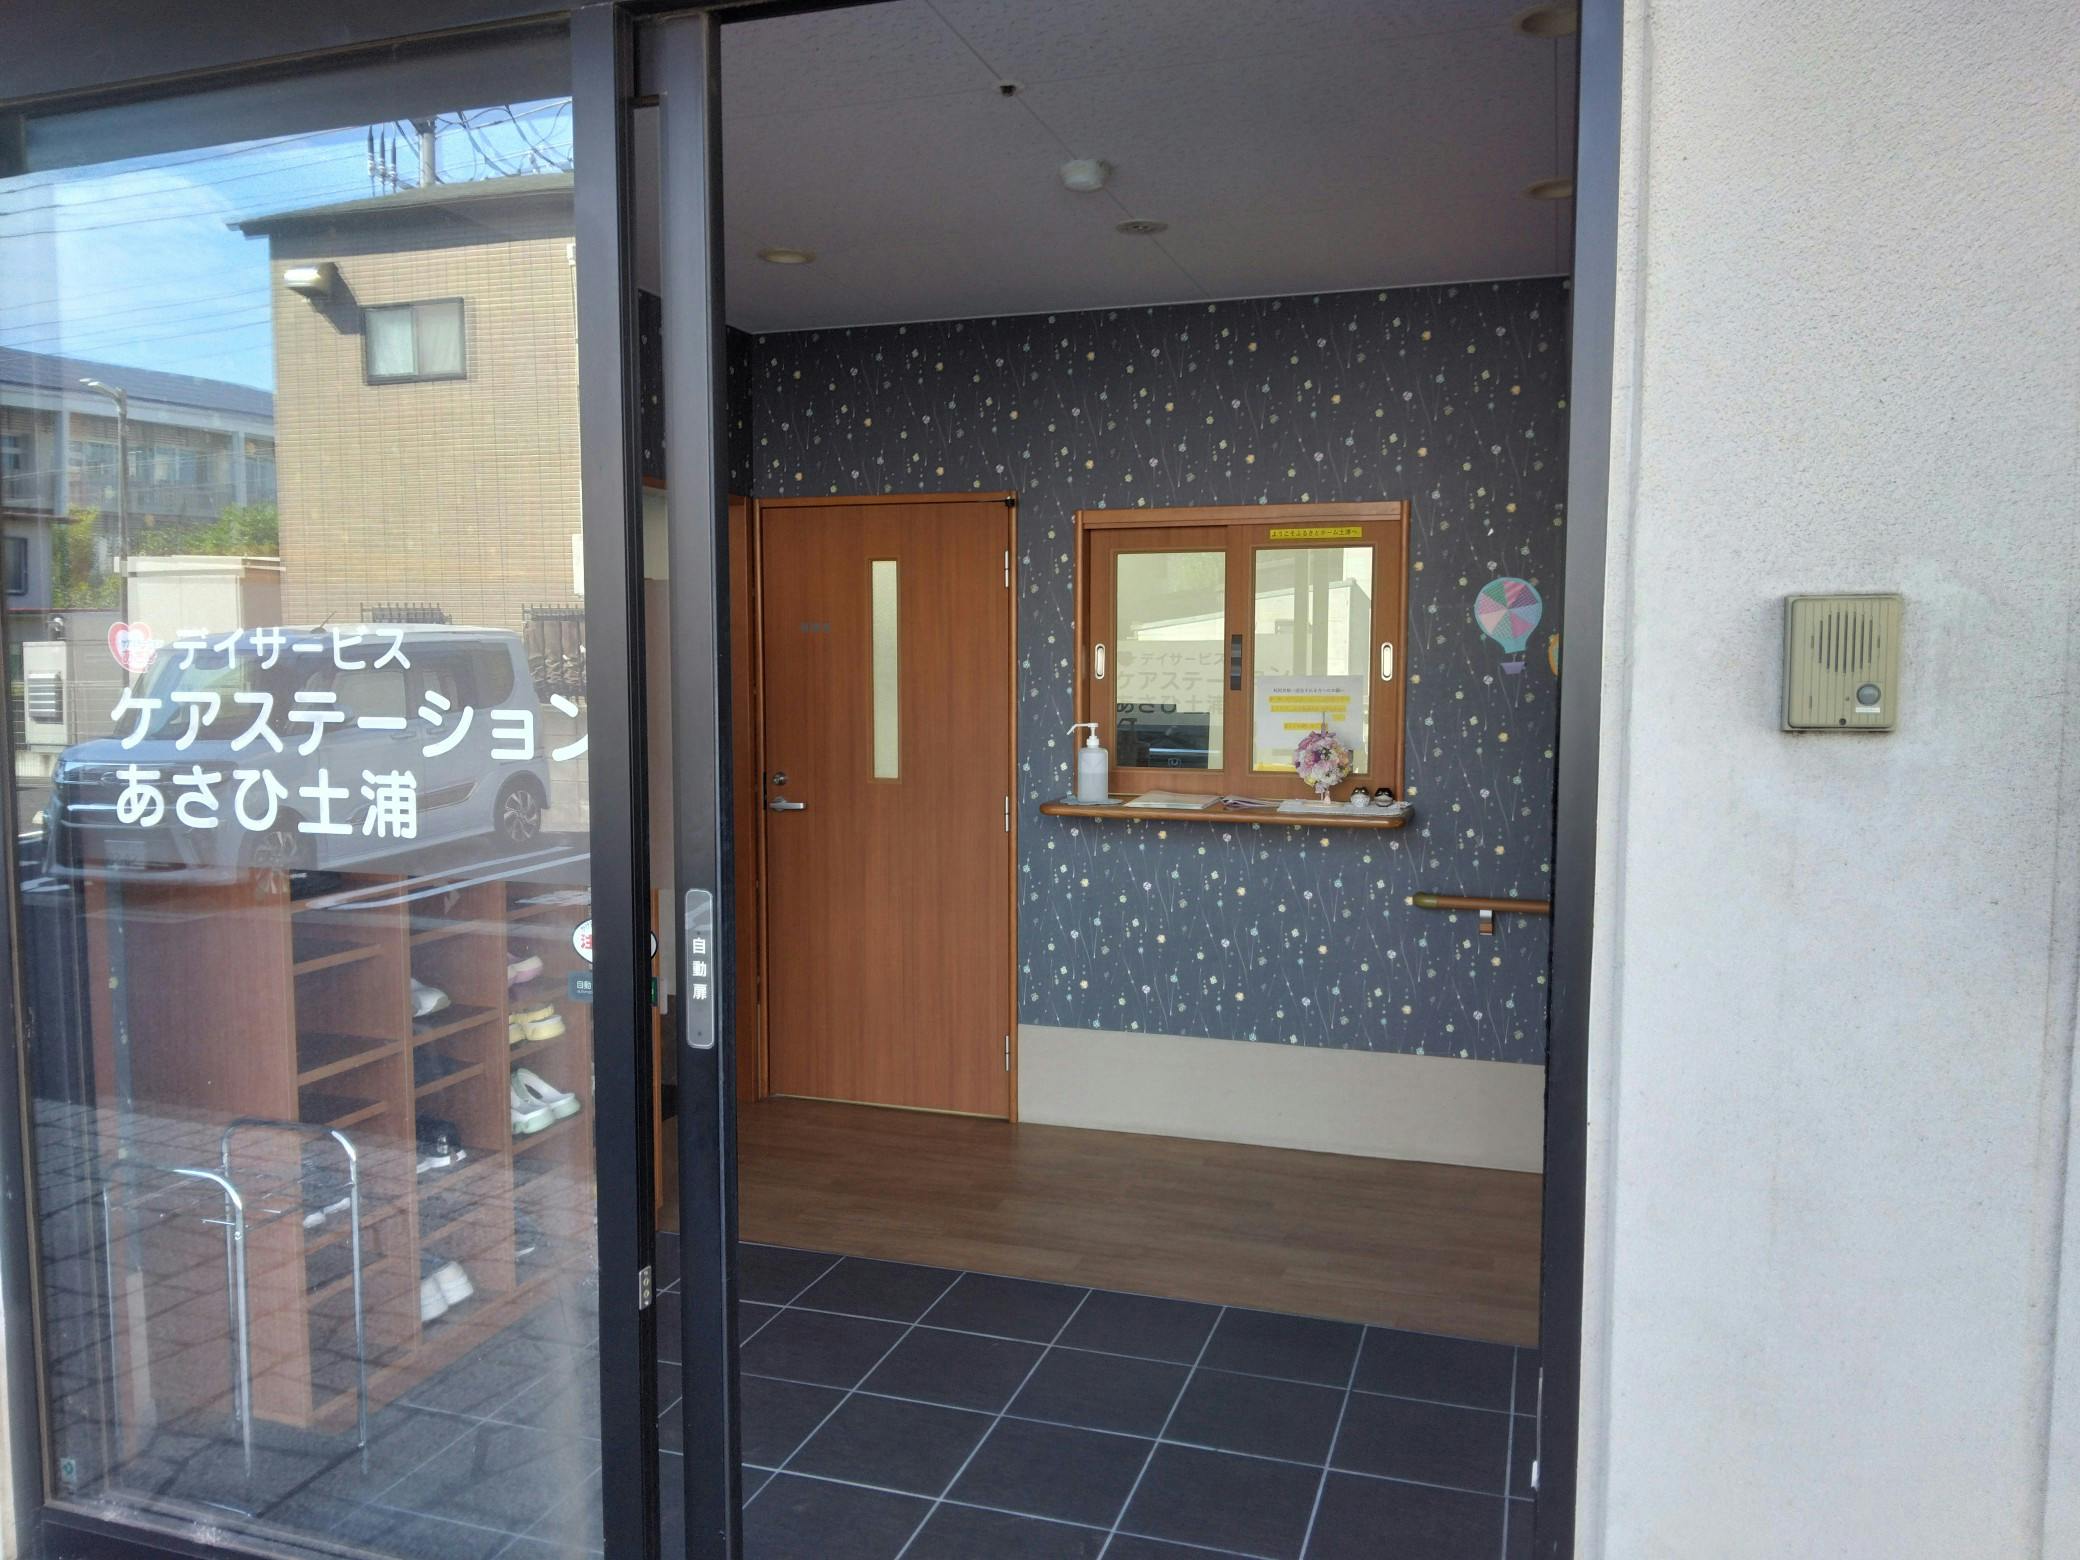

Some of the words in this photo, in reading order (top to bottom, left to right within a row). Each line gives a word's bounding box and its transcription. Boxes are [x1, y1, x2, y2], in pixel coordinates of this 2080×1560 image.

[173, 627, 412, 670] デイサービス
[110, 686, 589, 762] ケアステーション
[115, 763, 418, 839] あさひ土浦
[692, 937, 708, 1000] 自動扉
